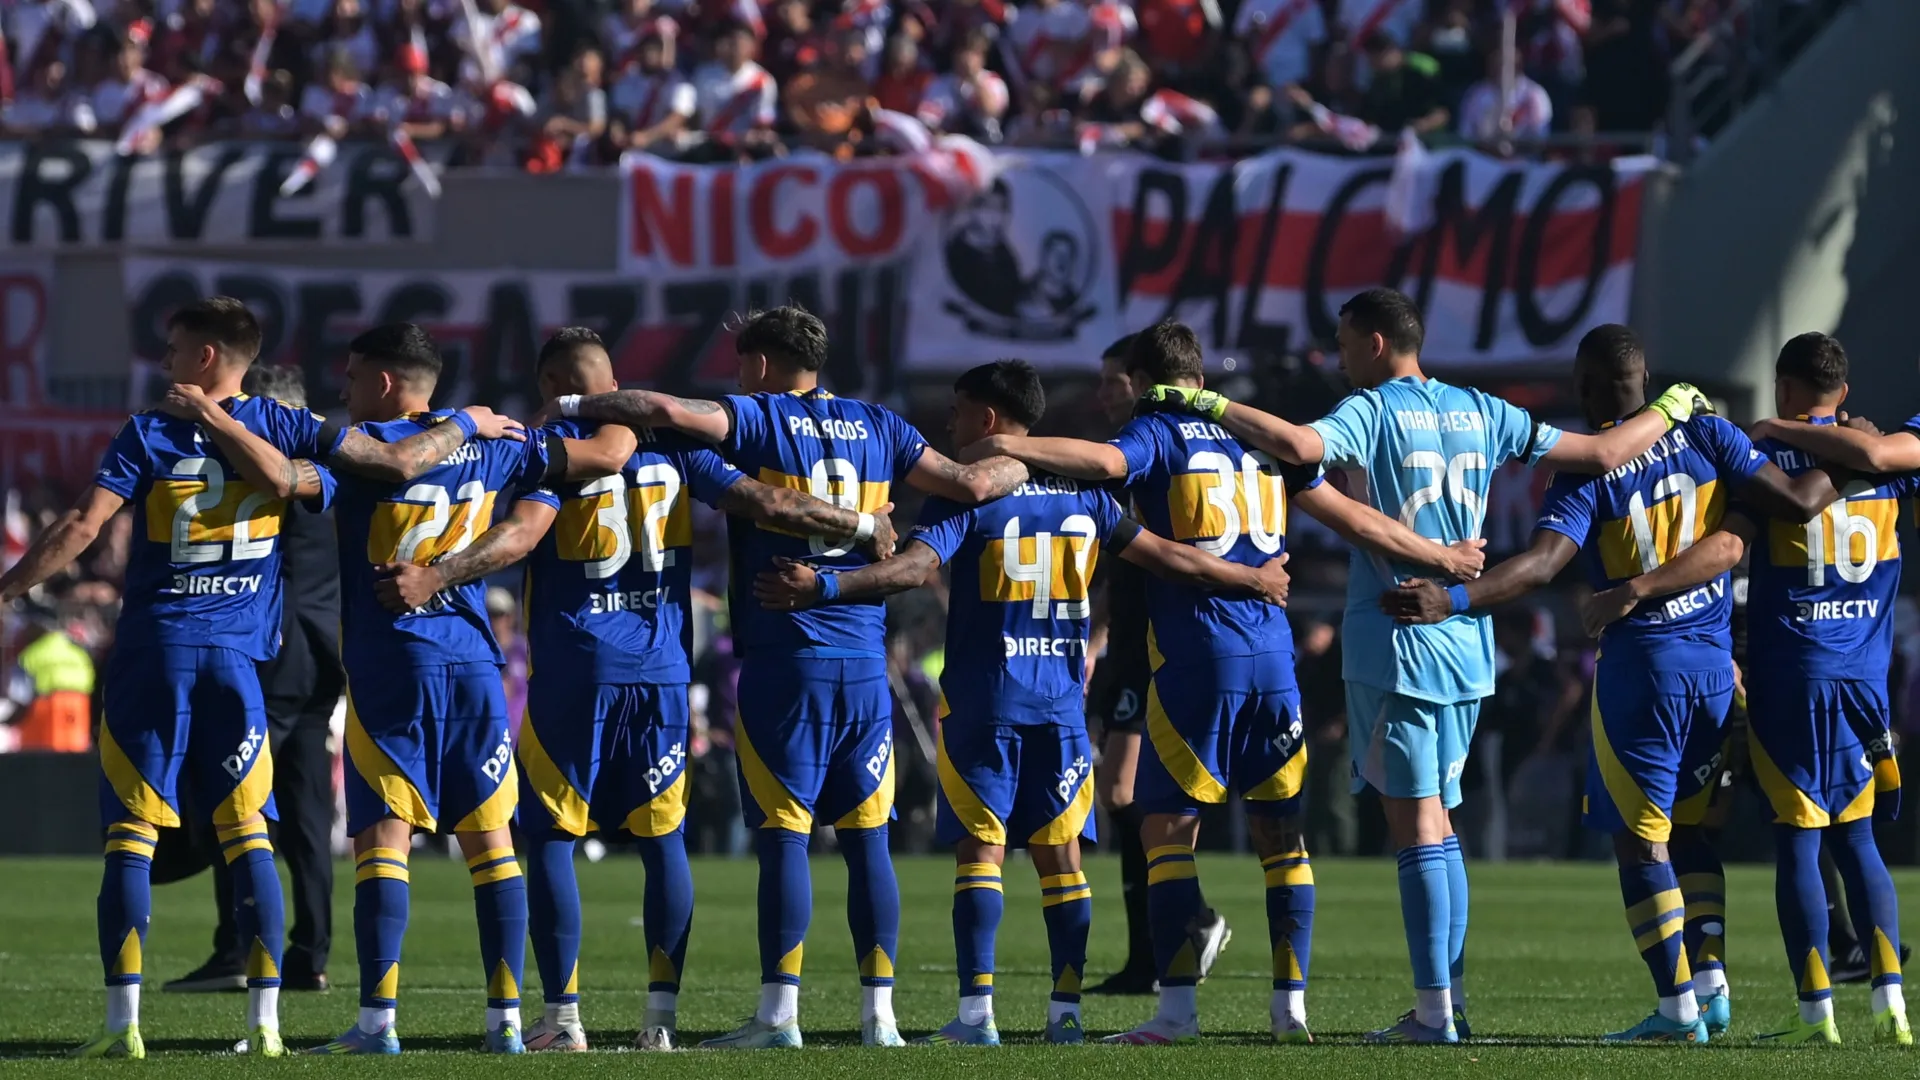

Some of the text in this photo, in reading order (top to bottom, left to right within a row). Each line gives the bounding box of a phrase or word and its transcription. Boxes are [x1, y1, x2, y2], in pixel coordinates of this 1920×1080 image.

[11, 140, 415, 241] RIVER
[630, 166, 904, 266] NICO
[1116, 161, 1614, 352] PALOMO
[172, 457, 274, 563] 22
[580, 463, 676, 579] 32
[809, 458, 858, 557] 8
[1188, 450, 1284, 557] 30
[1629, 473, 1698, 574] 17
[1806, 479, 1877, 586] 16
[172, 574, 263, 595] DIRECTV
[1003, 514, 1097, 619] 43
[1645, 579, 1724, 624] DIRECTV
[1796, 599, 1879, 621] DIRECTV
[221, 725, 262, 780] pax
[481, 728, 511, 784] pax
[641, 741, 686, 794] pax
[1056, 755, 1089, 803] pax
